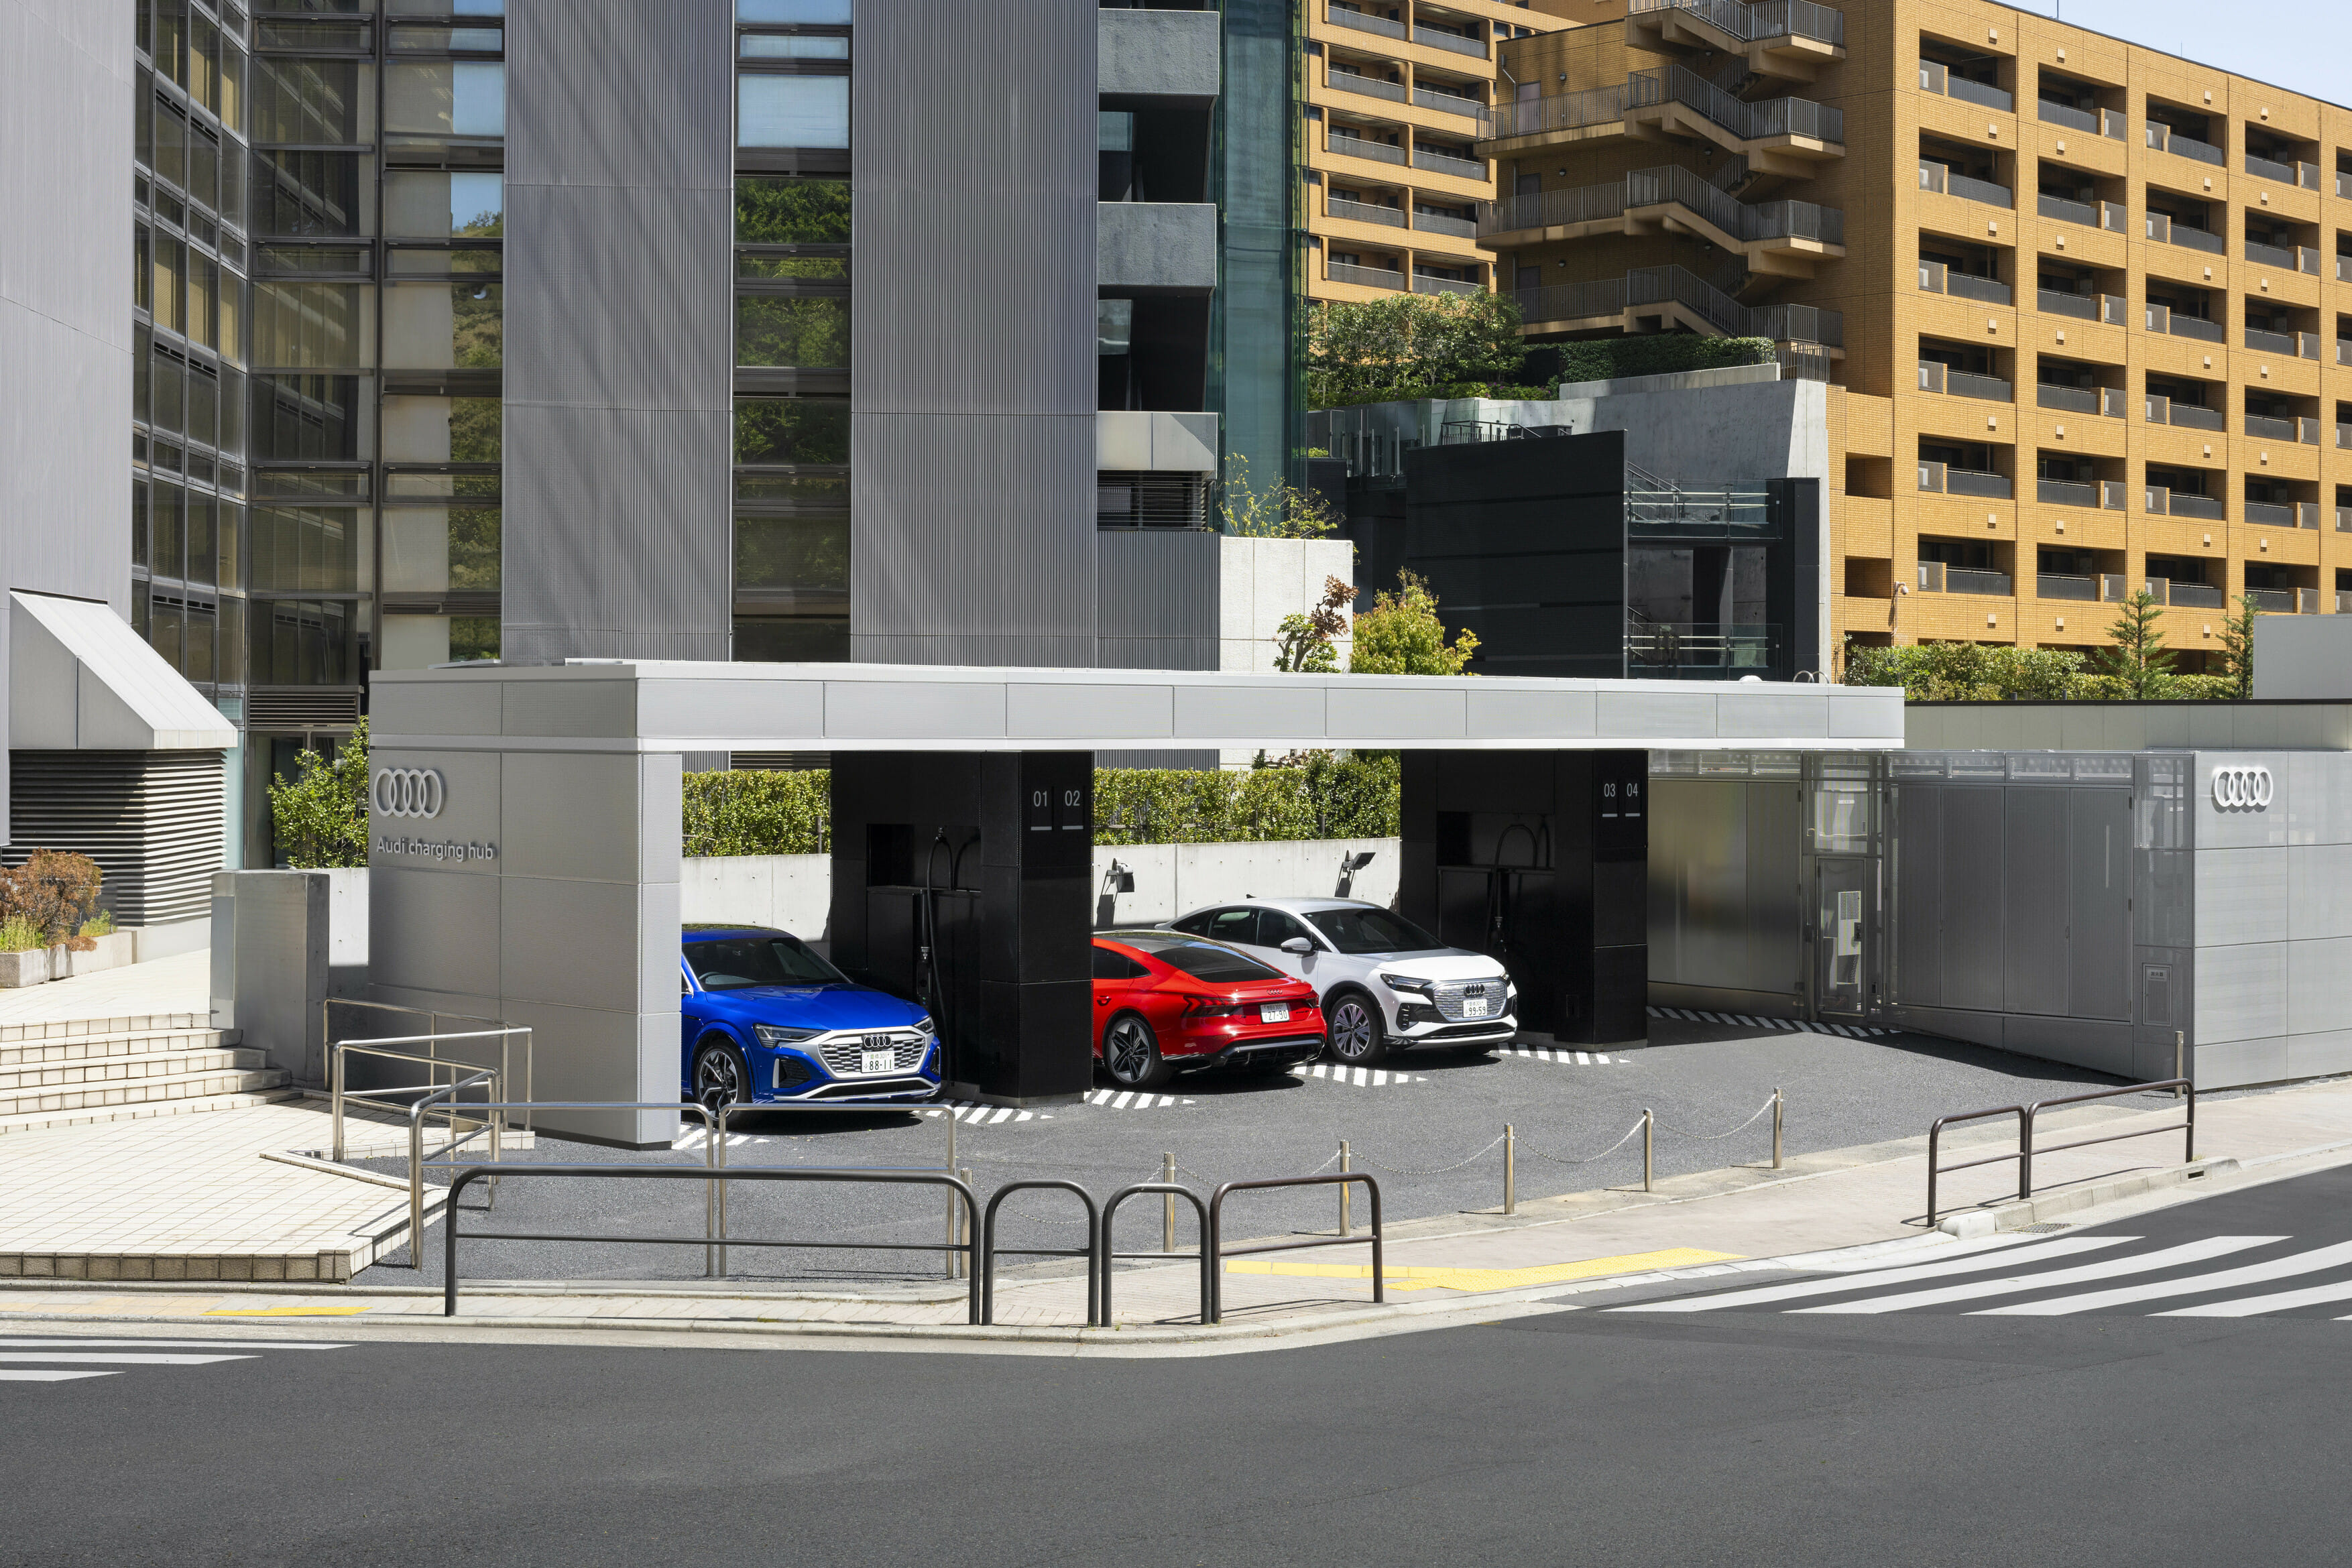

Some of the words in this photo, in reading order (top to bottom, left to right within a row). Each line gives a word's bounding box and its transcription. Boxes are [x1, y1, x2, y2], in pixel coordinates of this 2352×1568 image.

[1604, 783, 1616, 797] 03
[1627, 783, 1638, 797] 04
[1033, 790, 1047, 807] 01
[1065, 790, 1080, 806] 02
[376, 836, 406, 854] Audi
[408, 839, 464, 863] charging
[468, 841, 494, 860] hub
[1268, 1010, 1288, 1020] 27-90
[1469, 1006, 1486, 1016] 99-59
[869, 1059, 892, 1071] 88-11
